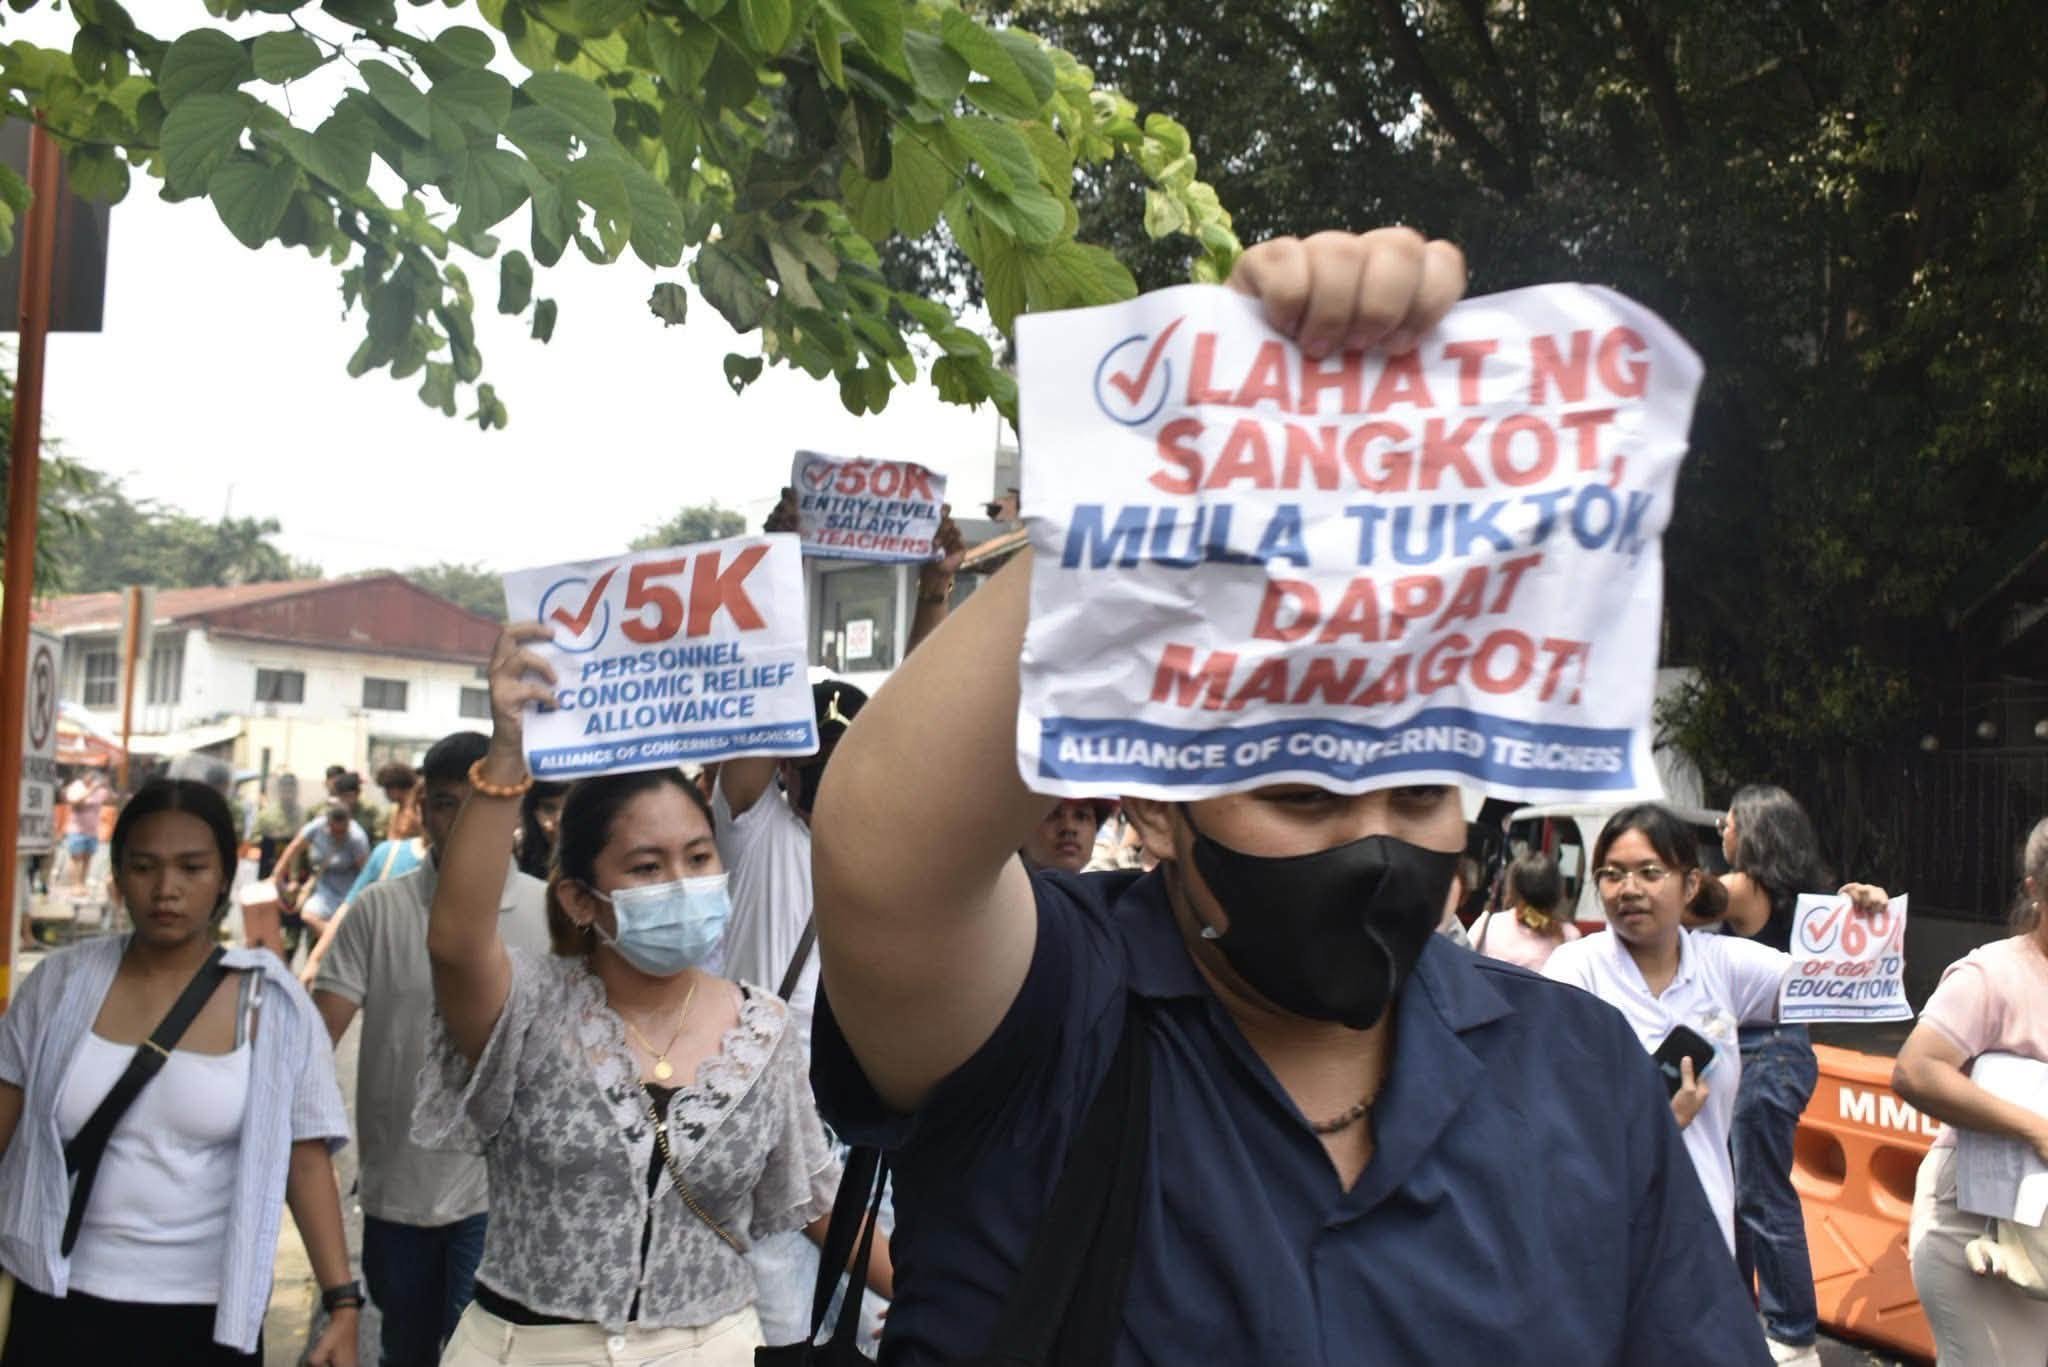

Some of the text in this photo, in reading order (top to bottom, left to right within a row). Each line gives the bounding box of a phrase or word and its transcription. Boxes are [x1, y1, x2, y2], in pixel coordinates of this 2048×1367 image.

[1186, 327, 1653, 416] LAHAT NG
[1148, 408, 1627, 496] SANGKOT,
[834, 460, 934, 501] 50K
[824, 514, 910, 536] SALARY
[1060, 503, 1310, 569] MULA
[620, 544, 774, 645] 5K
[1253, 553, 1541, 645] DAPAT
[581, 642, 745, 682] PERSONNEL
[703, 662, 796, 694] RELIEF
[1149, 629, 1590, 712] MANAGOT!
[584, 695, 755, 736] ALLOWANCE
[540, 748, 615, 769] ALLIANCE
[616, 743, 637, 760] OF
[1058, 735, 1228, 770] ALLIANCE
[1233, 736, 1283, 768] OF
[1802, 958, 1835, 977] OF
[1877, 957, 1900, 976] TO
